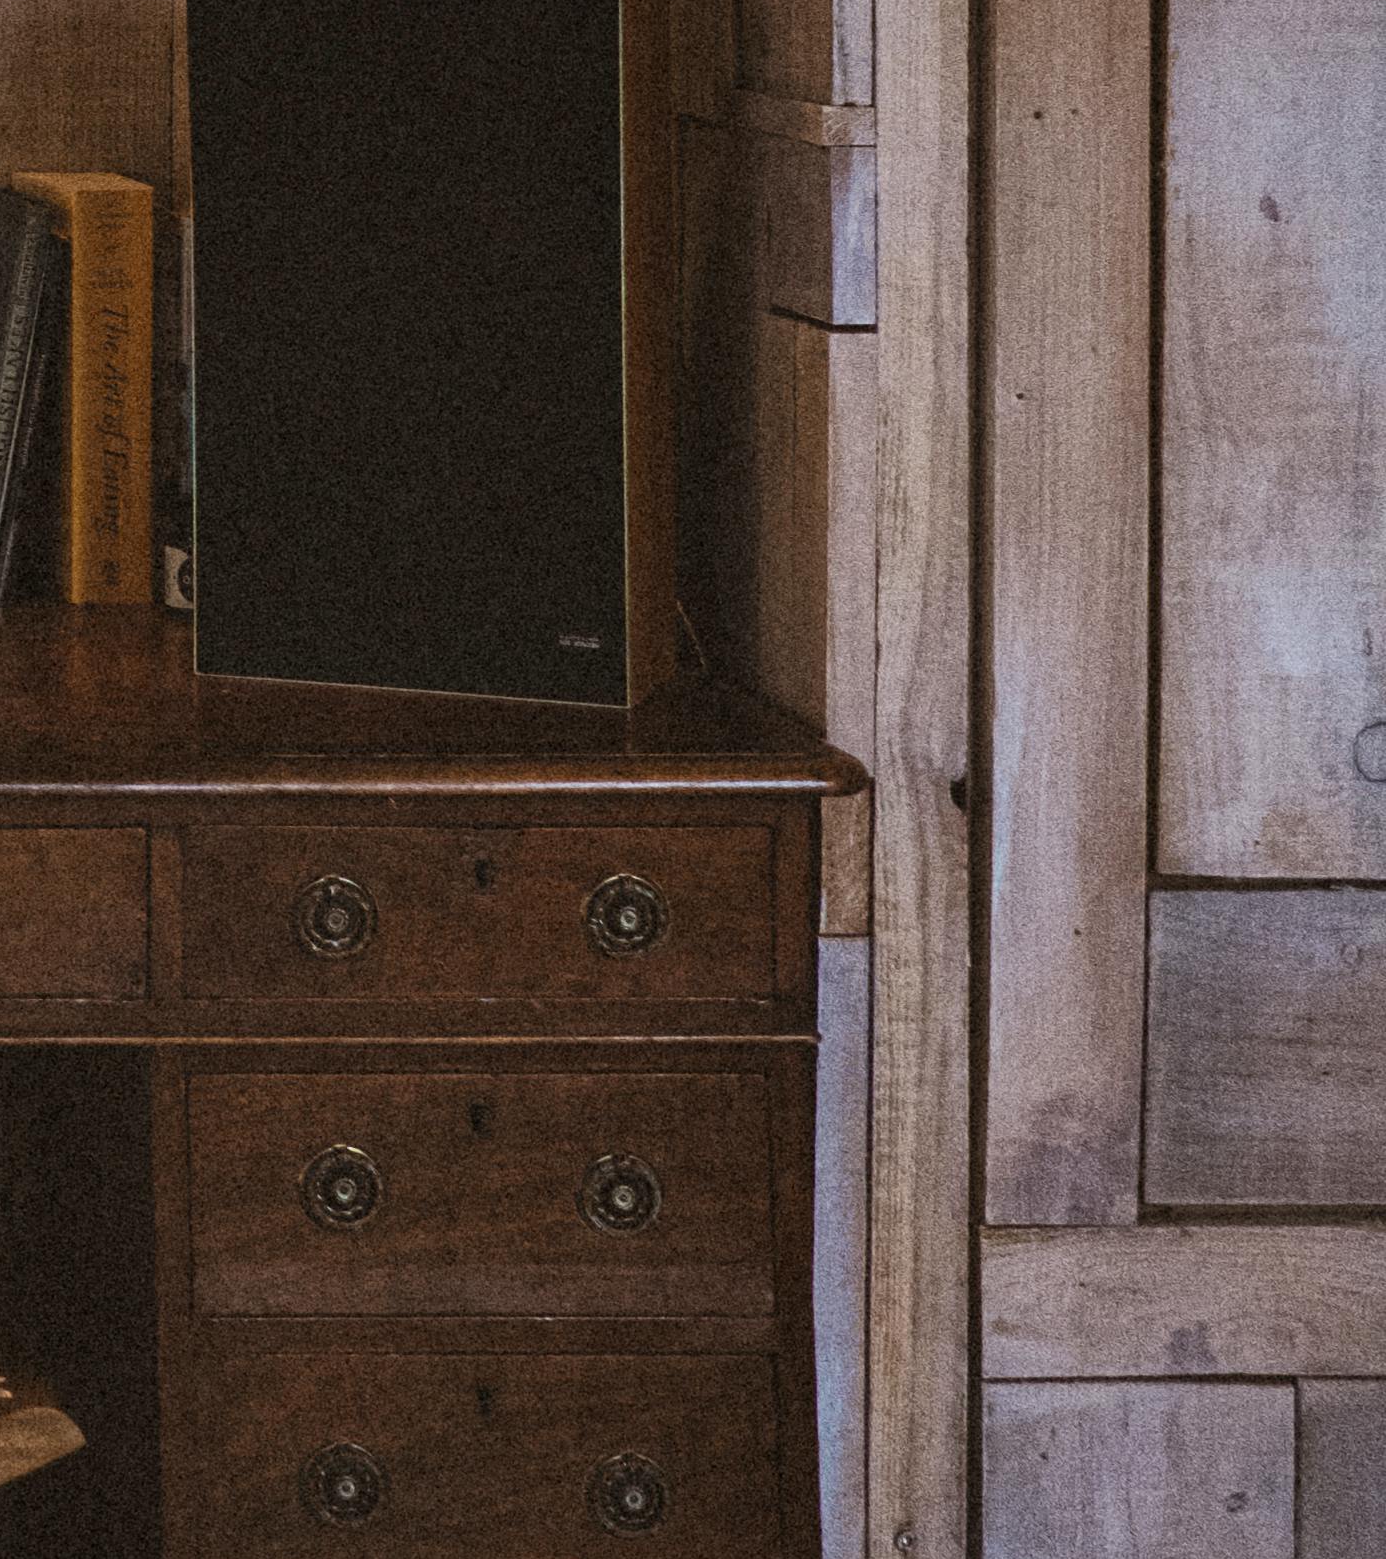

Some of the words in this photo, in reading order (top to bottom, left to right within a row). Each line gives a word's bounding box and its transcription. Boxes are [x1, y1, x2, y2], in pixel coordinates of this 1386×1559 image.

[102, 304, 129, 354] The
[103, 361, 128, 412] Art
[98, 413, 132, 444] of
[90, 447, 129, 536] Eating
